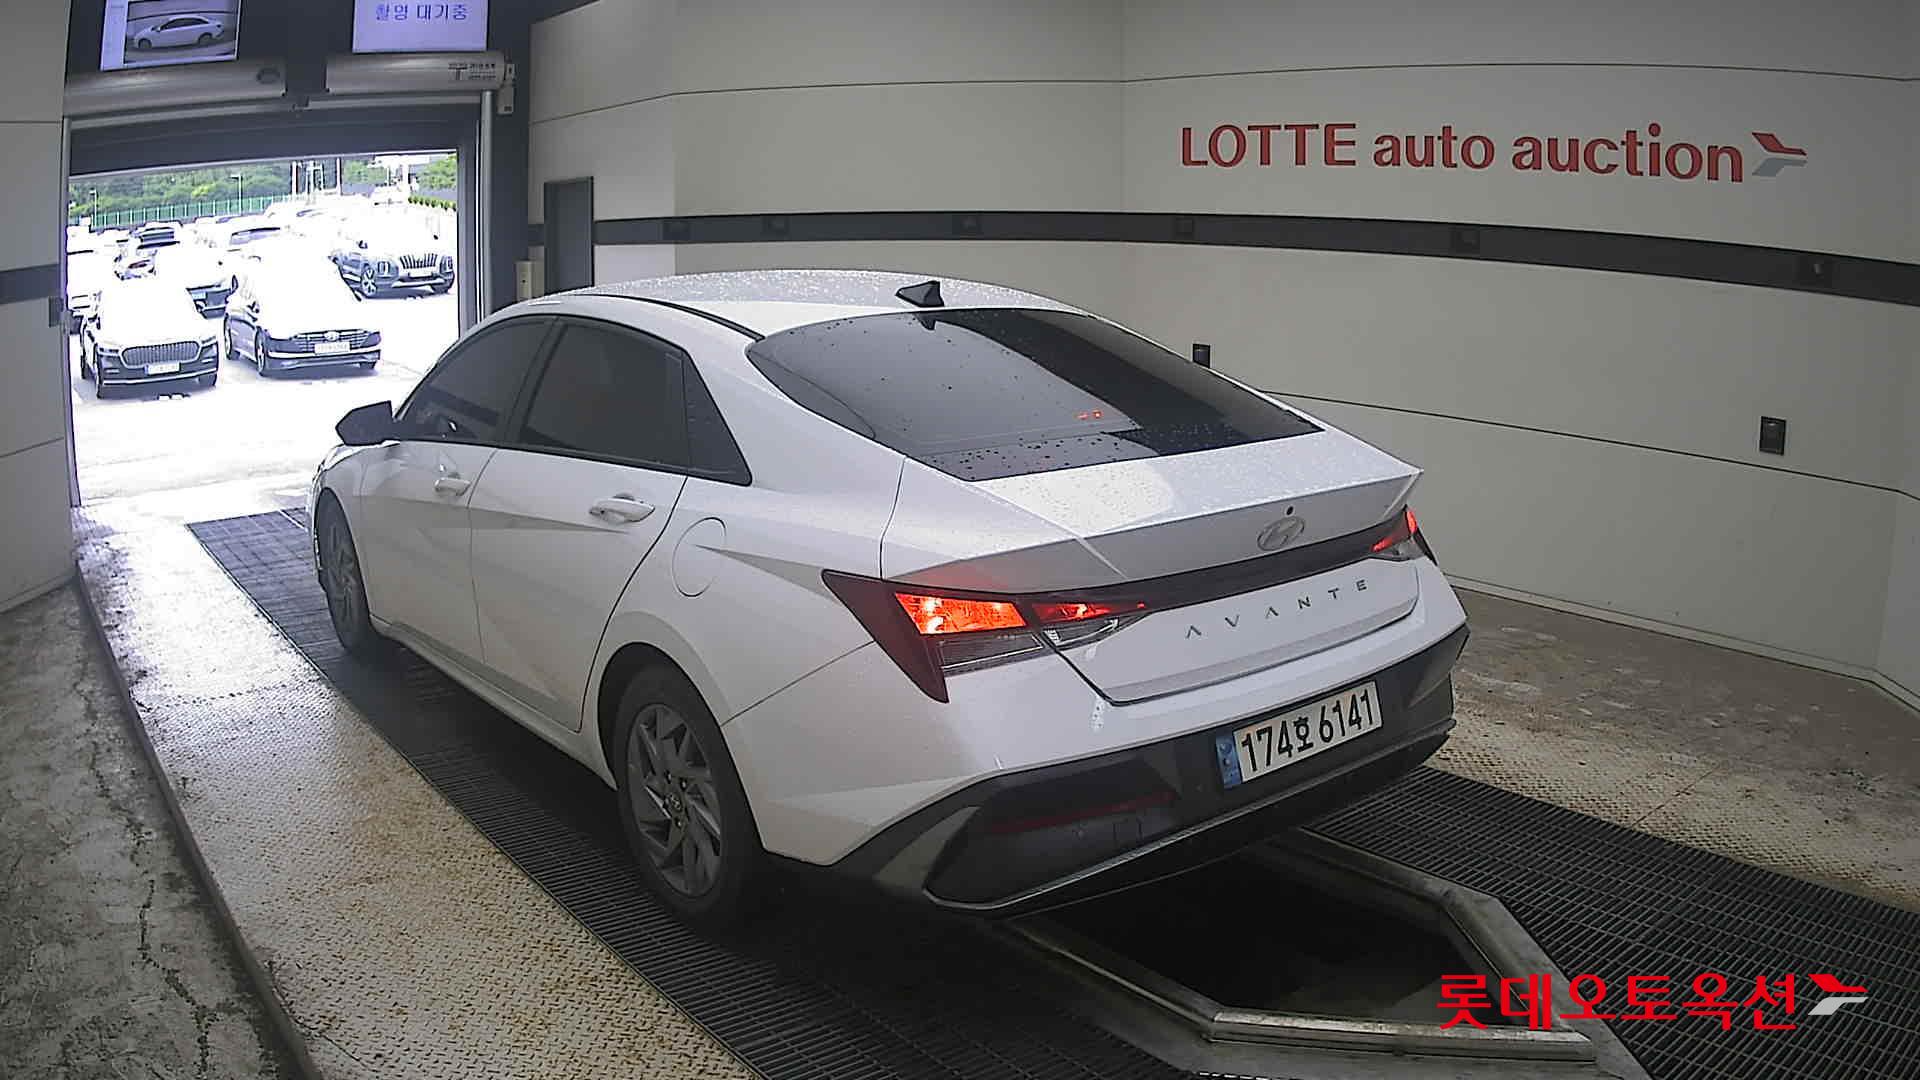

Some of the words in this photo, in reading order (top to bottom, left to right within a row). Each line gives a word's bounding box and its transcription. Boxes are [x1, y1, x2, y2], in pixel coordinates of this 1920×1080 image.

[417, 4, 467, 21] 대기중
[1181, 124, 1356, 167] LOTTE
[1373, 126, 1495, 168] auto
[1512, 123, 1744, 182] auction
[1185, 579, 1368, 639] AVANTE
